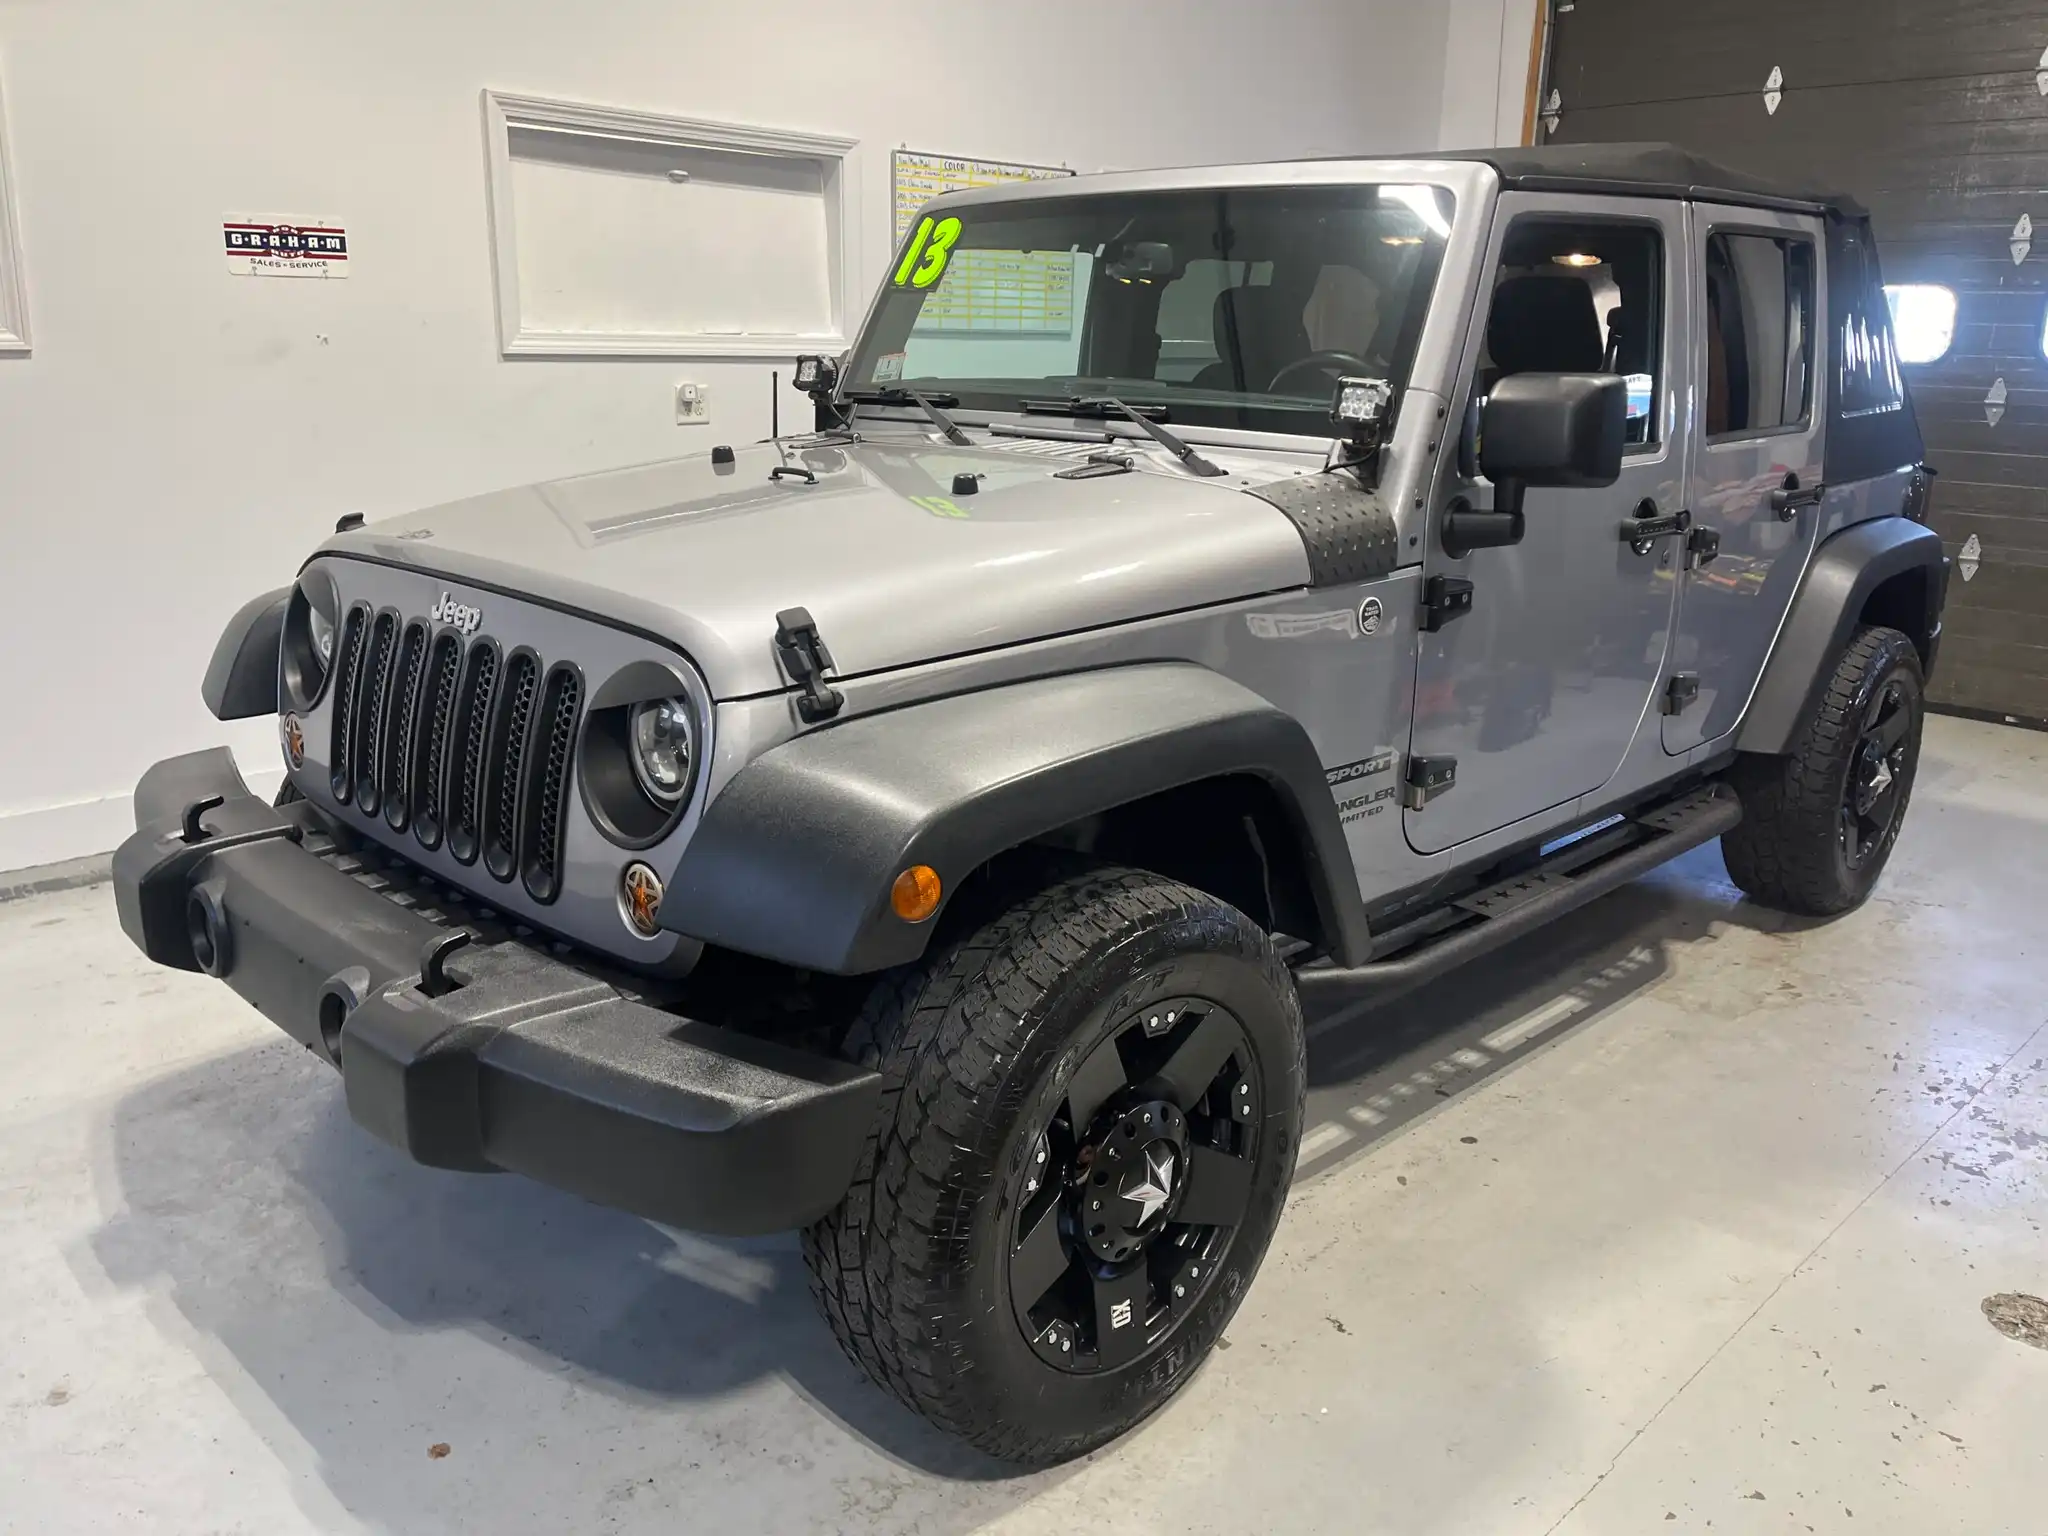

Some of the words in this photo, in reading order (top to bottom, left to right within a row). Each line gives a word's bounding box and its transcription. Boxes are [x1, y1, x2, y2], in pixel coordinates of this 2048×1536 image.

[250, 257, 281, 268] SALES
[289, 260, 328, 269] SERVICE
[271, 249, 304, 257] AUTO
[894, 216, 962, 287] 13
[432, 592, 481, 636] Jeep
[1325, 756, 1391, 784] SPORT
[1337, 786, 1396, 813] NGLER
[1341, 805, 1384, 824] IMITED
[1110, 1297, 1132, 1331] XD
